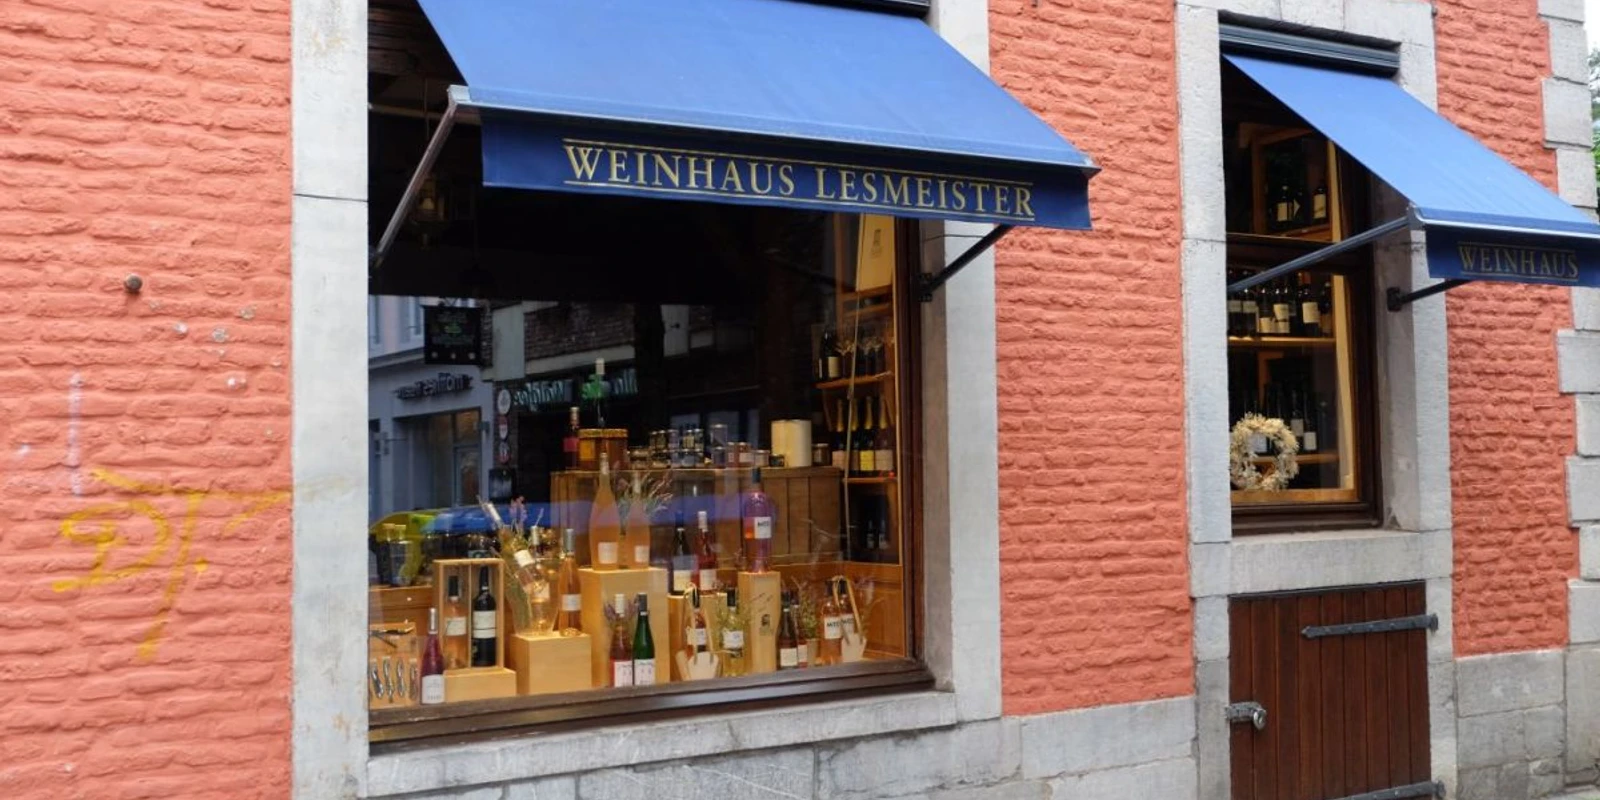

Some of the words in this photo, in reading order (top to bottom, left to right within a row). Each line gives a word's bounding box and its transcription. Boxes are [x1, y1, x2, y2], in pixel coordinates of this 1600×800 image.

[563, 145, 796, 196] WEINHAUS
[814, 167, 1035, 217] LESMEISTER
[1458, 245, 1579, 278] WEINHAUS
